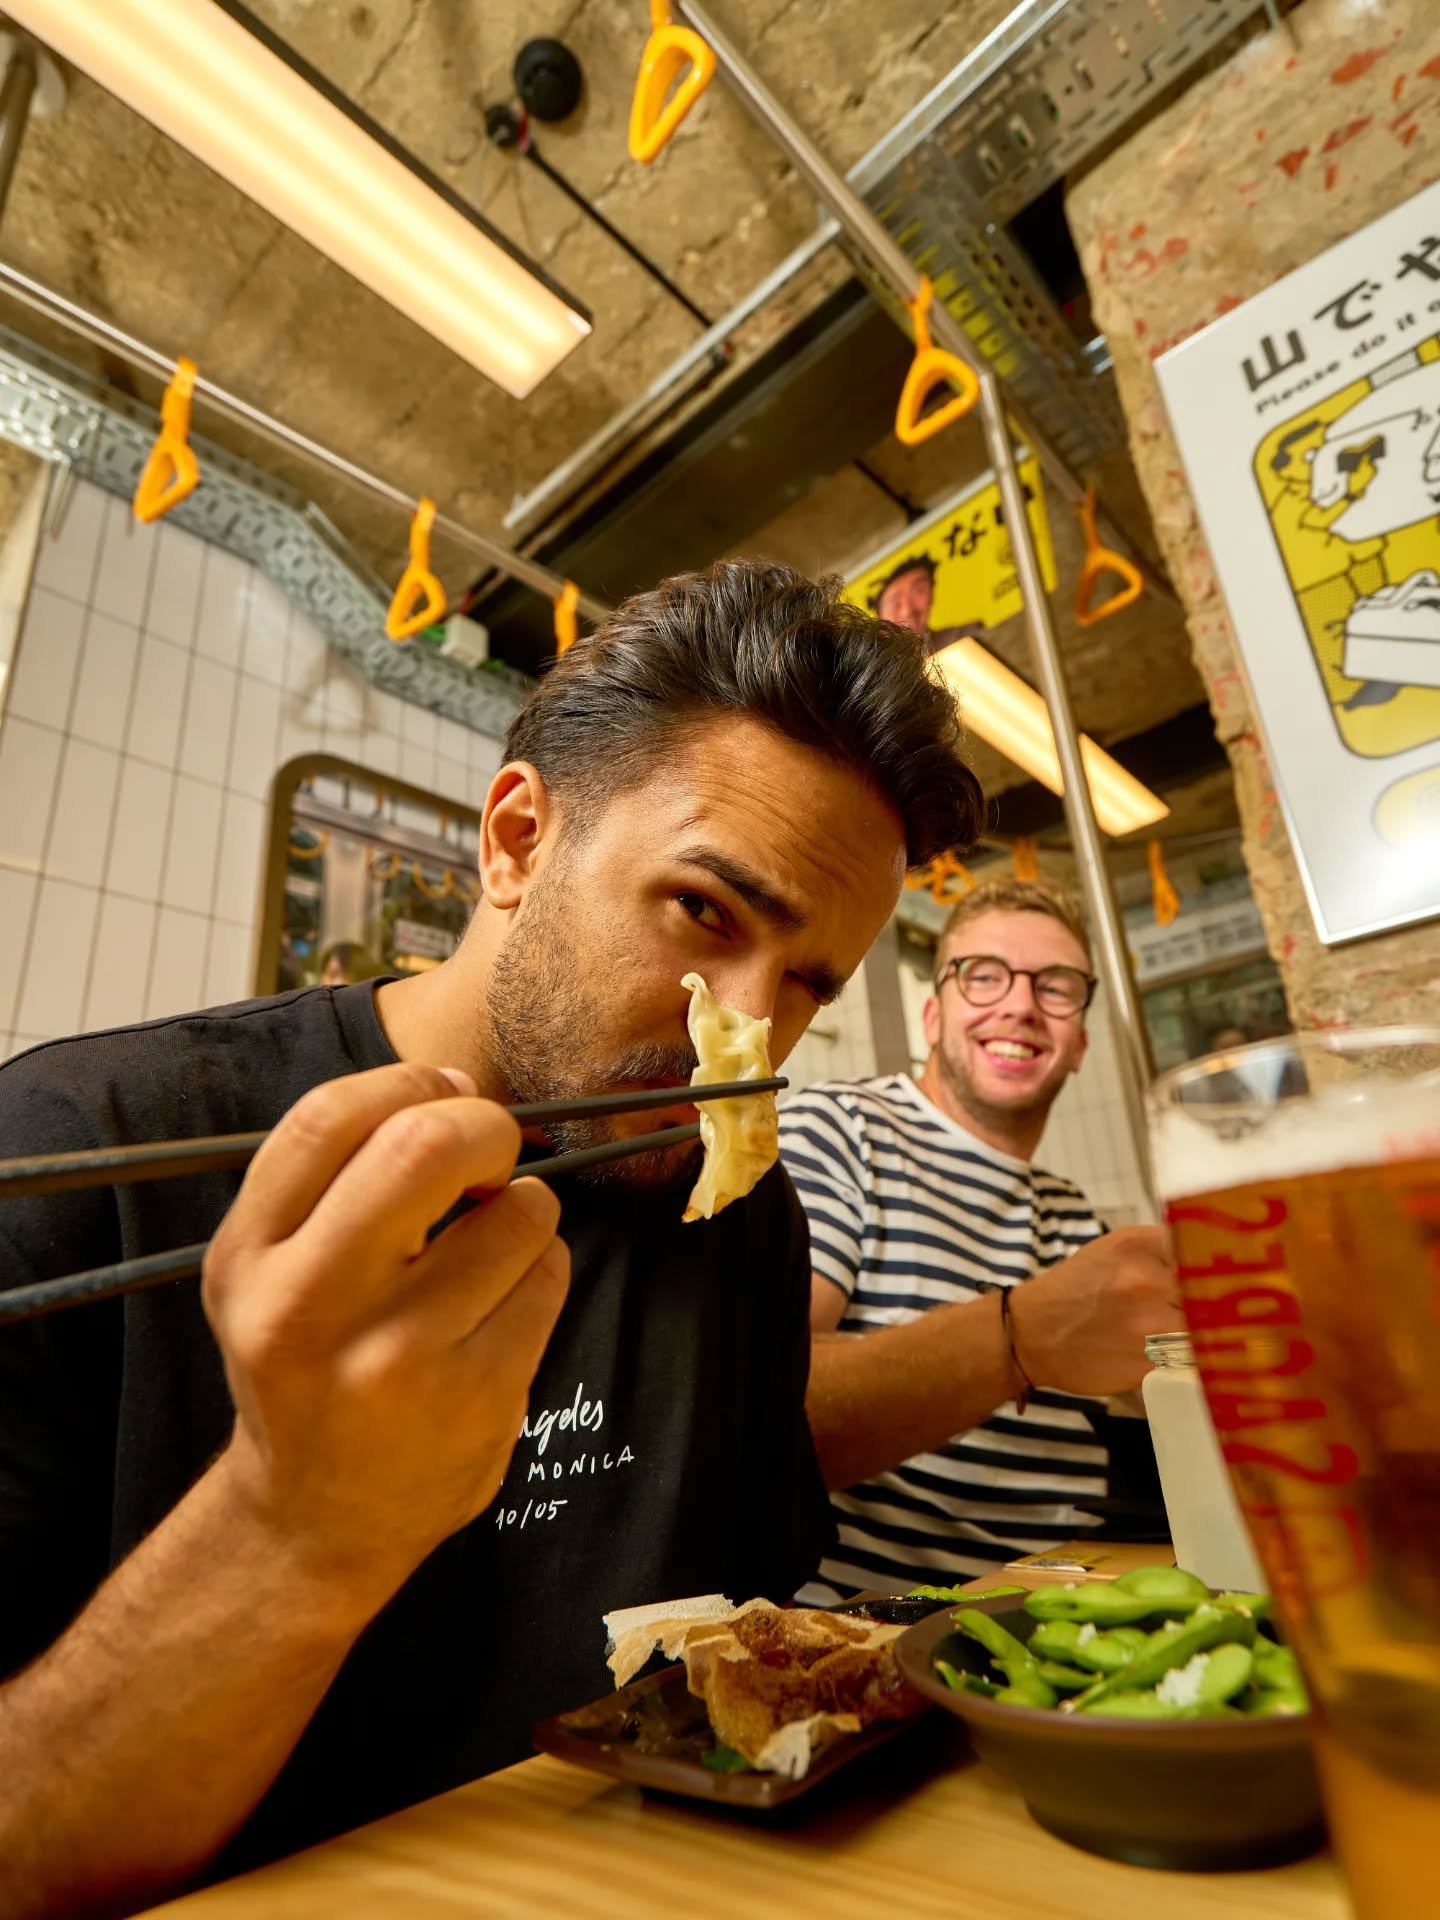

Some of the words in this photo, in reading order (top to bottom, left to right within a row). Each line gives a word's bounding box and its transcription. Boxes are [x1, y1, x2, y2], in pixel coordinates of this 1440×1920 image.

[1255, 360, 1341, 414] Please
[1352, 333, 1387, 359] do
[1395, 312, 1416, 331] it
[527, 1445, 635, 1482] MONICA
[496, 1499, 568, 1530] 10/05
